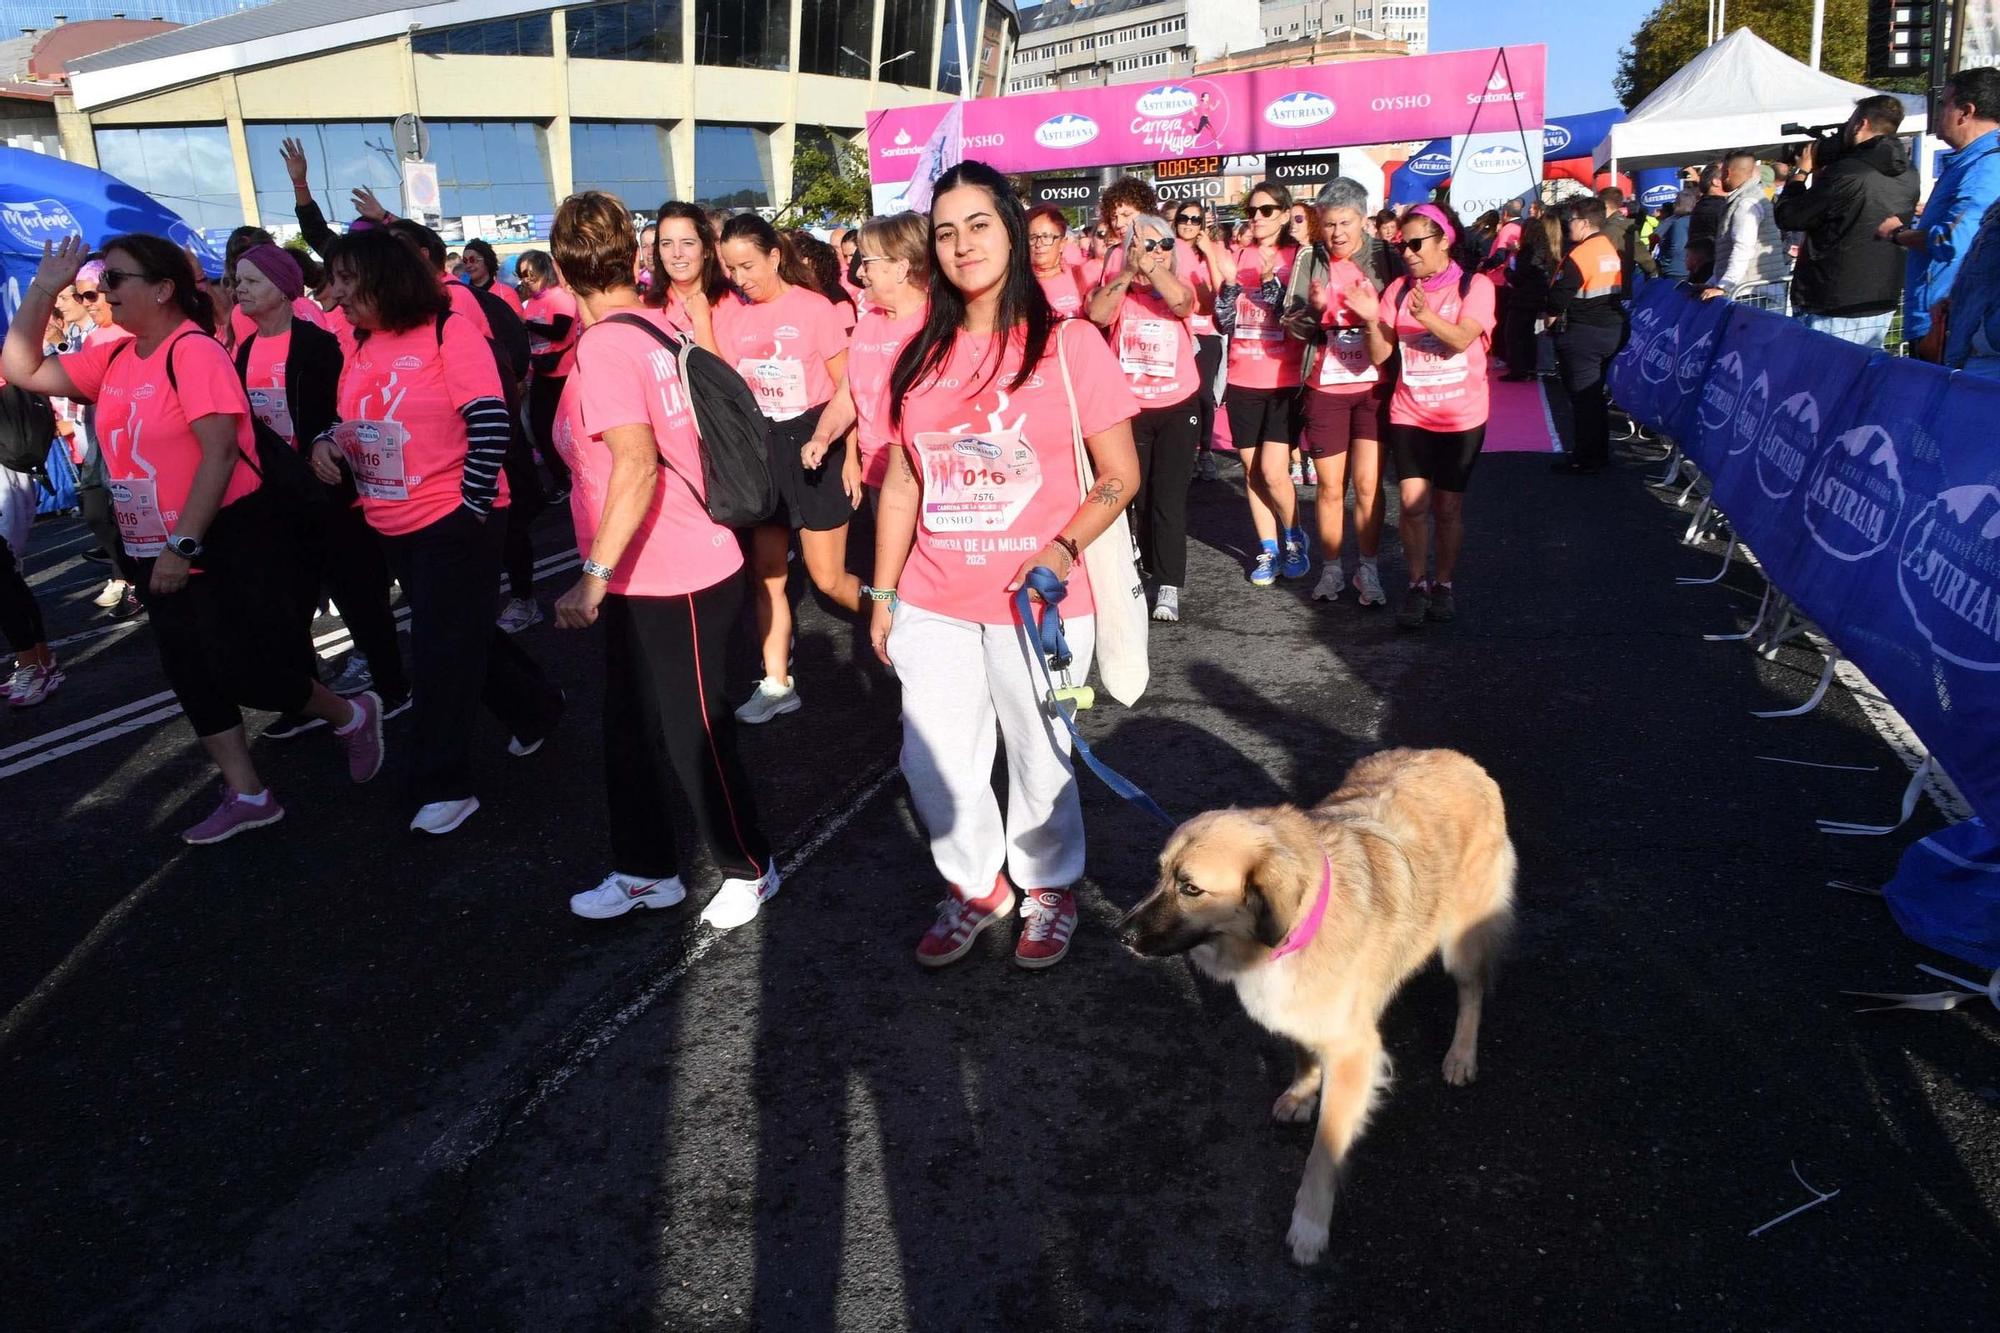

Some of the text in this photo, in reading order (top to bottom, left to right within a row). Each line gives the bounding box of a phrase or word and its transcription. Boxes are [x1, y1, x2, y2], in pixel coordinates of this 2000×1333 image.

[1371, 94, 1431, 112] OYSHO
[1270, 107, 1331, 120] ASTURIANA
[1160, 128, 1199, 155] Mujer
[1158, 157, 1219, 178] 00:05:32
[1275, 163, 1330, 178] OYSHO
[1040, 186, 1091, 201] OYSHO
[1158, 181, 1222, 201] OYSHO
[762, 387, 784, 397] 016
[963, 469, 1006, 485] 016
[973, 493, 994, 501] 7576
[1809, 457, 1886, 543] ASURIANA
[936, 515, 973, 525] OYSHO
[964, 539, 979, 552] DE
[981, 539, 995, 552] LA
[998, 536, 1037, 552] MUJER
